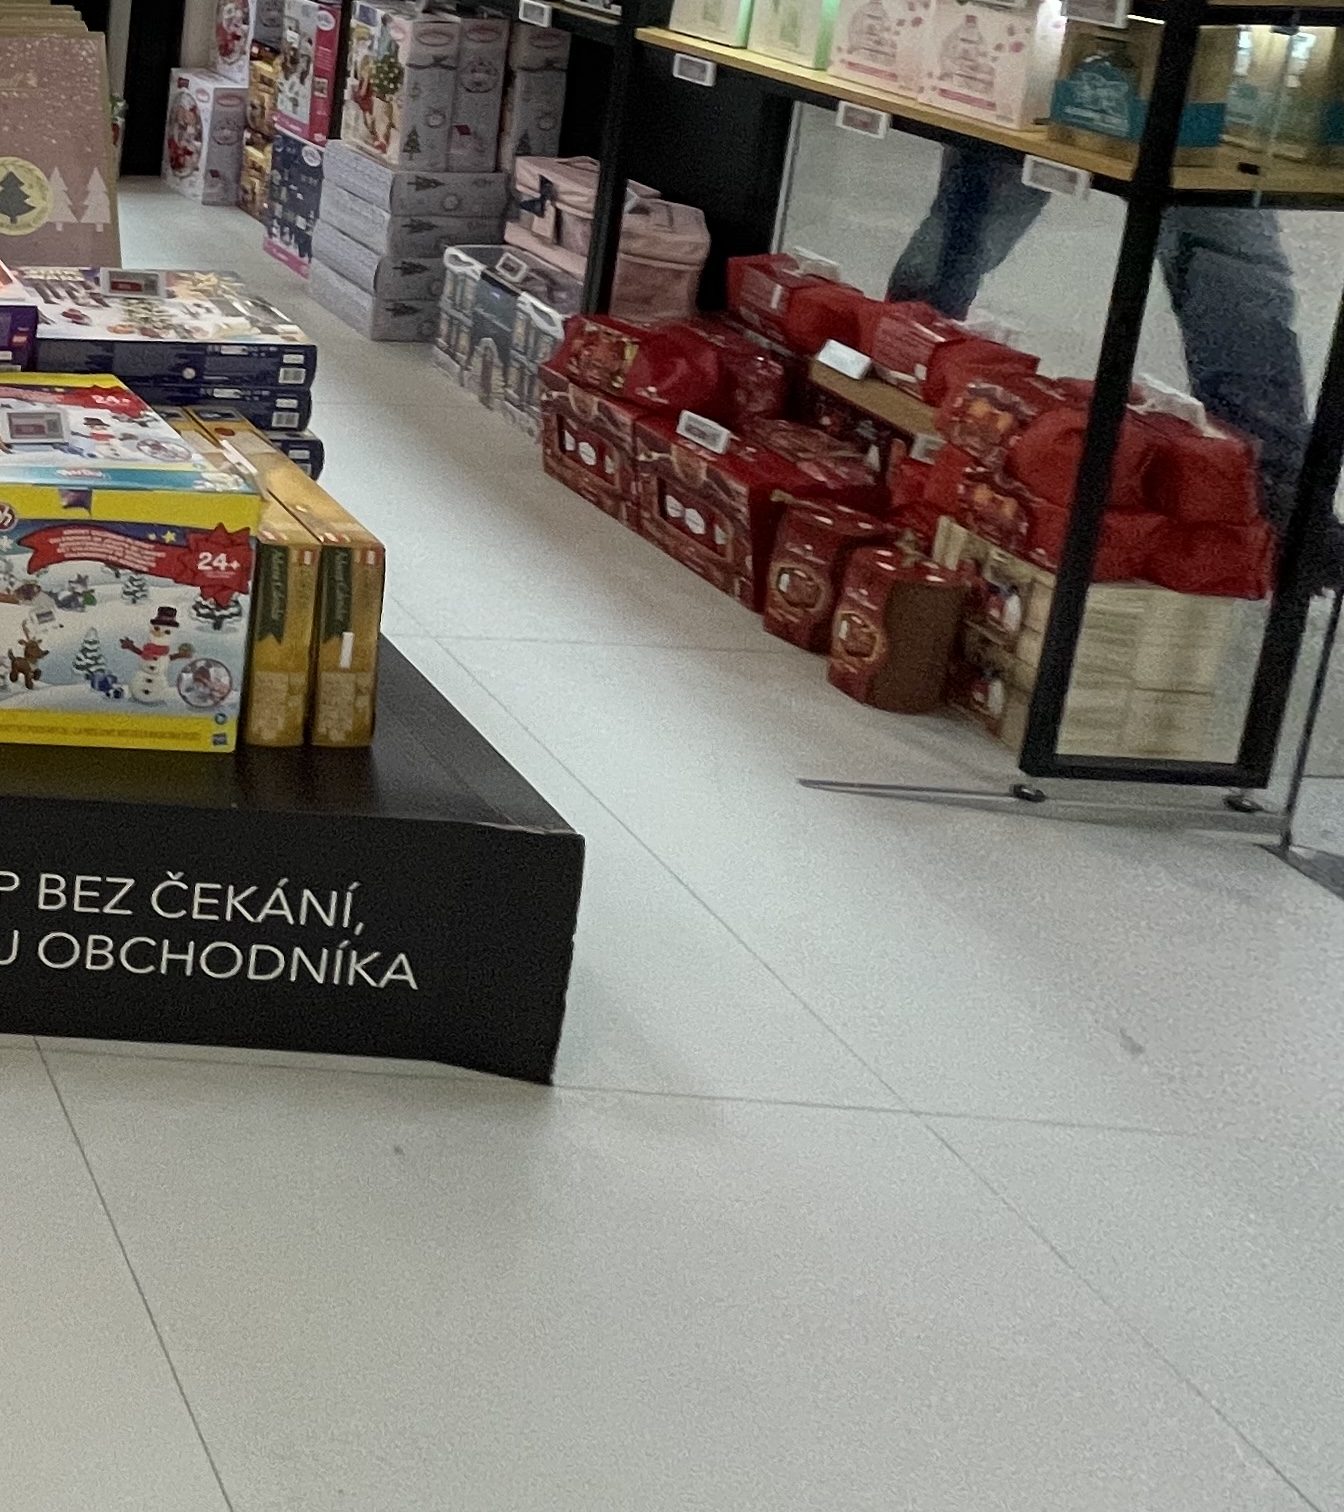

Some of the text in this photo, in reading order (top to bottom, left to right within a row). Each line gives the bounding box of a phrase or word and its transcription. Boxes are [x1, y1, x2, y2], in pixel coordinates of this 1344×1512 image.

[198, 550, 241, 572] 24+
[37, 873, 135, 918] BEZ
[150, 870, 366, 937] ČEKÁNÍ,
[37, 930, 419, 990] OBCHODNÍKA
